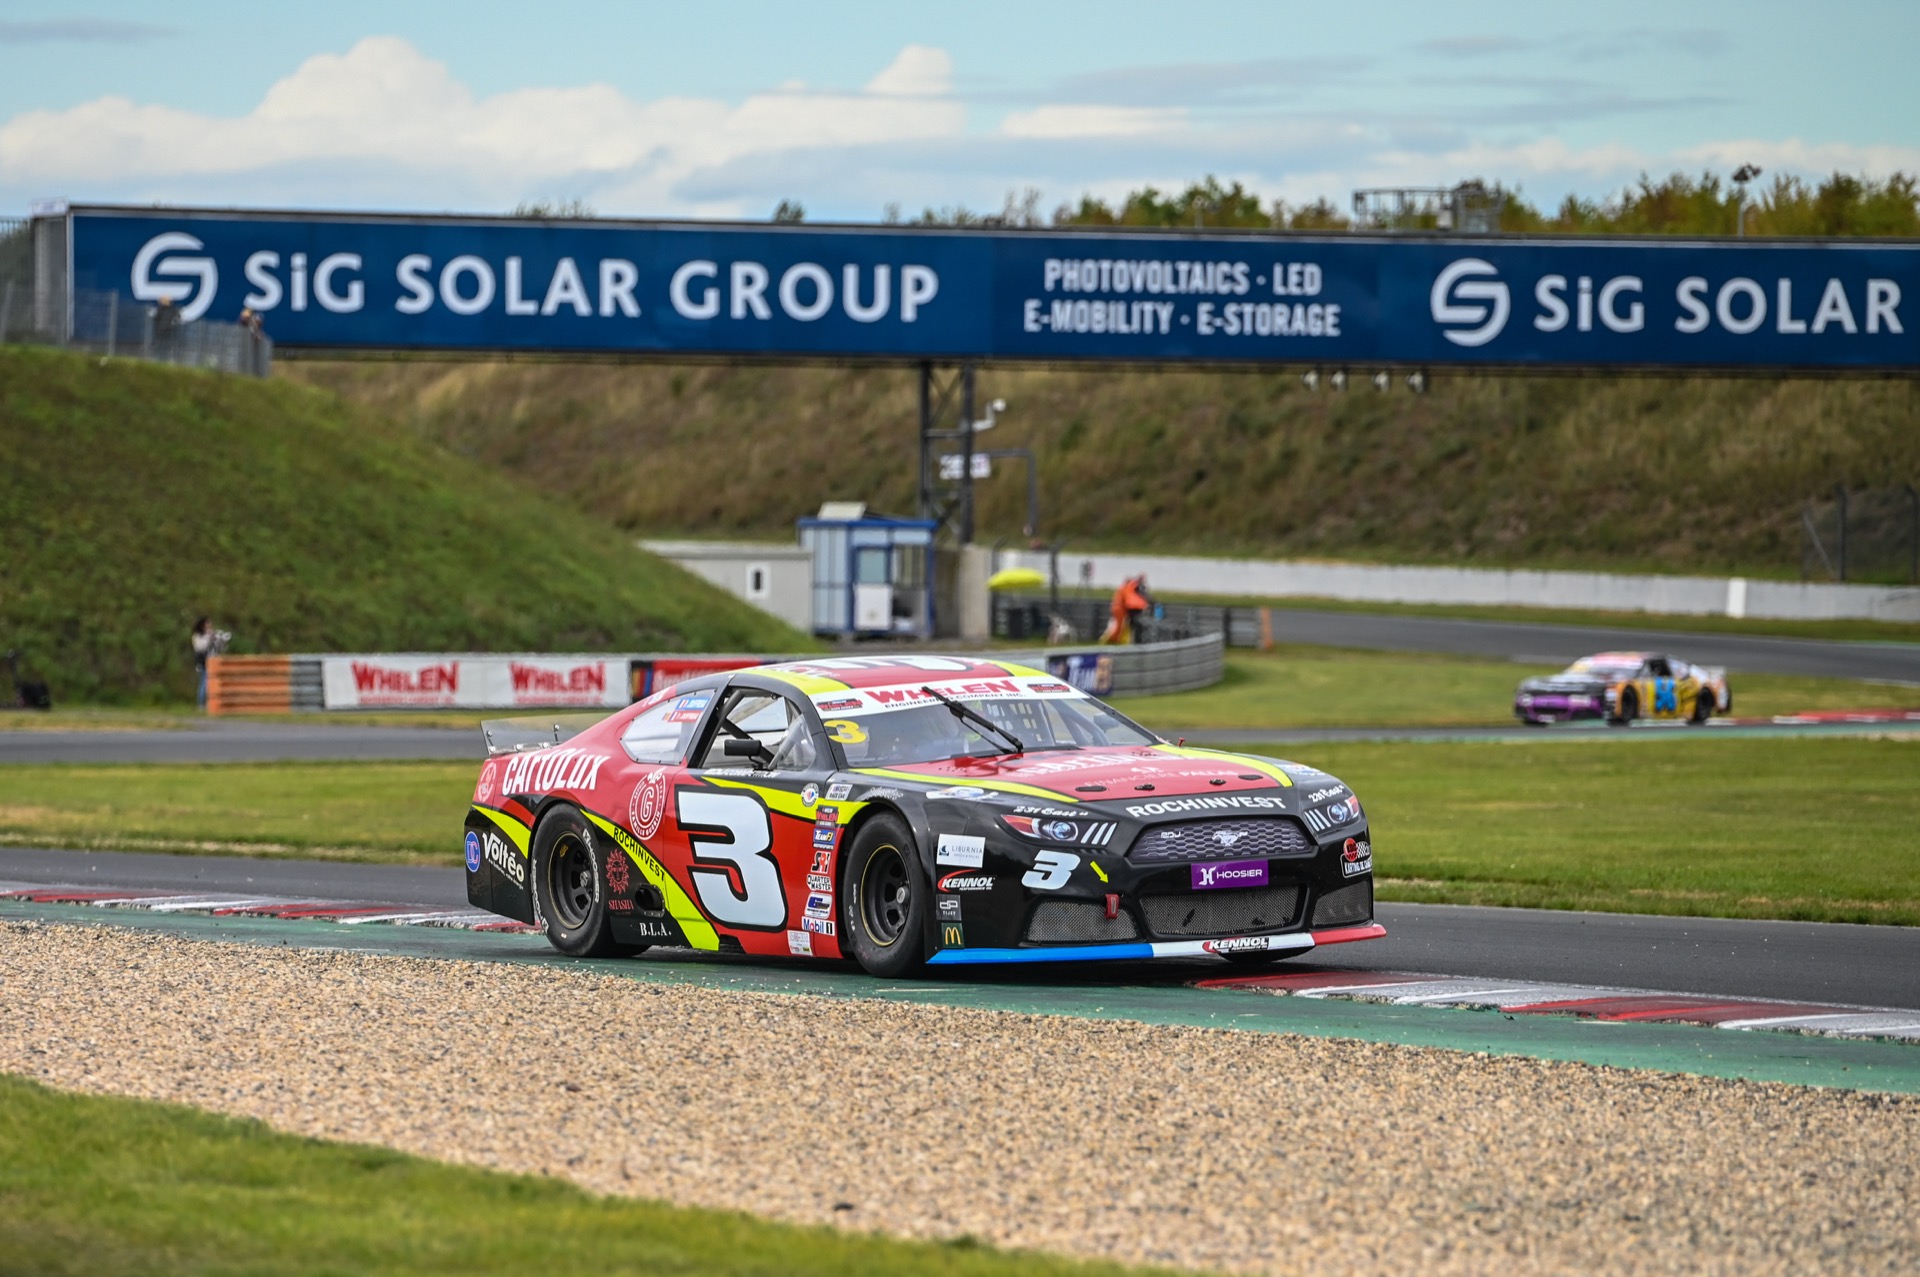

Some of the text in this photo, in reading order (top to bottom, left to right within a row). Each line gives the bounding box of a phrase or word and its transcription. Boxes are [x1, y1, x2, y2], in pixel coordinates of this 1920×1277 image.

[243, 250, 939, 322] SiG SOLAR GROUP
[1043, 258, 1322, 297] PHOTOVOLTAICS LED
[1024, 299, 1341, 338] E-MOBILITY E-STORAGE
[1534, 274, 1904, 335] SiG SOLAR
[352, 661, 459, 693] WHELEN
[510, 661, 605, 693] WHELEN
[864, 680, 1022, 704] WHELEN
[823, 719, 867, 744] 3
[1125, 796, 1288, 818] ROCHINVEST
[613, 827, 666, 881] ROCHINVEST
[678, 791, 786, 928] 3
[952, 845, 983, 854] LIBURNIA
[941, 876, 994, 889] KENNOL
[1021, 849, 1081, 890] 3
[1216, 869, 1263, 880] HOOSIER
[639, 922, 672, 937] B.L.A.
[803, 918, 824, 934] Mobil
[1209, 938, 1268, 950] KENNOL
